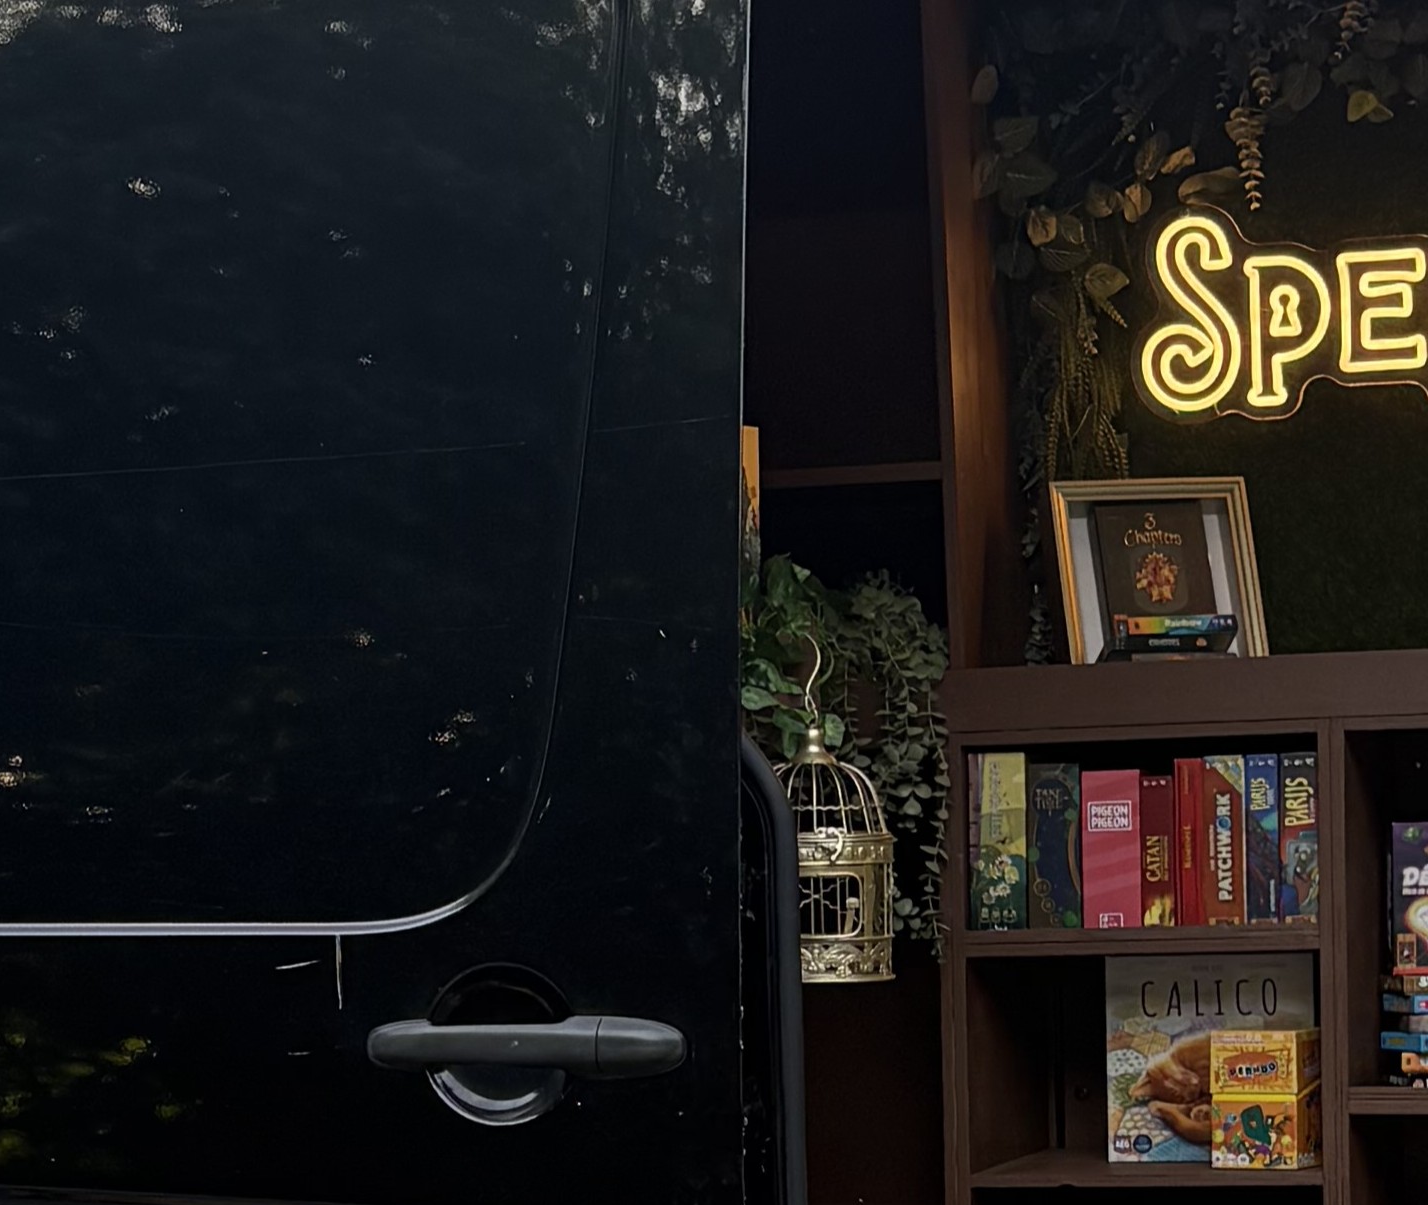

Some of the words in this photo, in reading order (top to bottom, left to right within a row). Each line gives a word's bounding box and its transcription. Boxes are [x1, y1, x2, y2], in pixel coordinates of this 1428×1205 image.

[1144, 512, 1156, 530] 3
[1124, 529, 1183, 548] Chapters
[1250, 777, 1267, 811] PARIJS
[1285, 776, 1306, 827] PARIJS
[1090, 805, 1129, 818] PIGEON
[1090, 817, 1130, 830] PIGEON
[1145, 835, 1160, 883] CATAN
[1218, 793, 1232, 901] PATCHWORK
[1140, 978, 1278, 1018] CALICO
